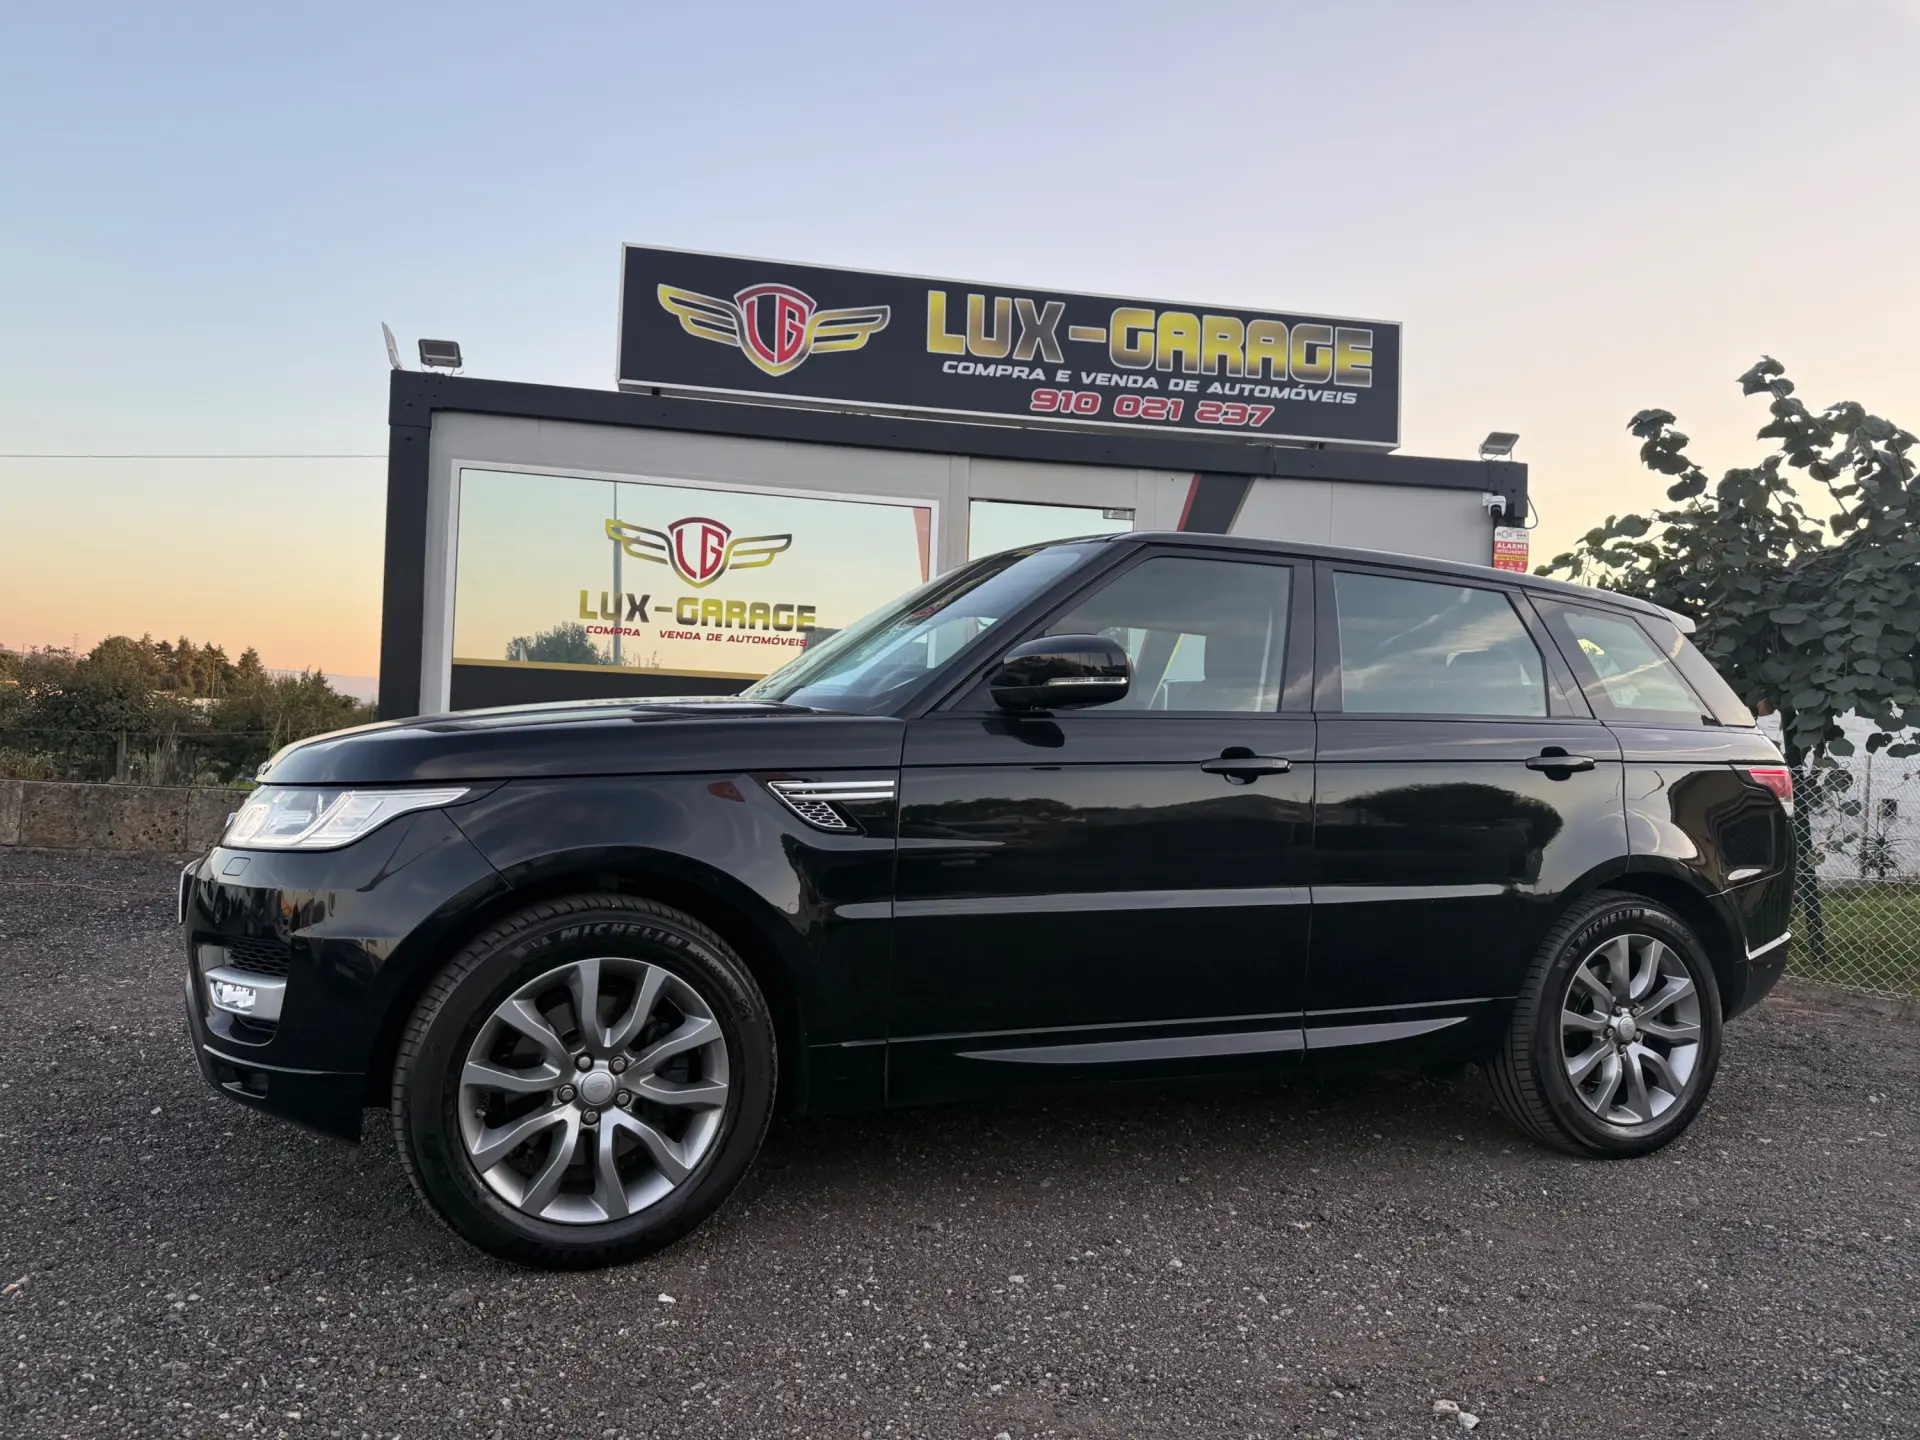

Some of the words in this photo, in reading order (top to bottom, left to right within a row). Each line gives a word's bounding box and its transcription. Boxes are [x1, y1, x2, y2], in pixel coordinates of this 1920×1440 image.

[926, 290, 1374, 388] LUX-GARAGE
[942, 360, 1046, 382] COMPRA
[1056, 370, 1071, 384] E
[1081, 371, 1159, 389] VENDA
[1168, 378, 1199, 393] DE
[1207, 381, 1358, 405] AUTOMÓVEIS
[1030, 388, 1102, 416] 910
[1113, 394, 1184, 422] 021
[1194, 400, 1275, 427] 237
[1496, 542, 1528, 551] ALARME
[579, 590, 817, 632] LUX-GARAGE
[586, 625, 642, 637] COMPRA
[659, 630, 701, 641] VENDA
[706, 633, 723, 642] DE
[726, 634, 808, 647] AUTOMÓVEIS
[560, 923, 684, 949] MICHELIN
[1577, 909, 1641, 949] MICHELIN
